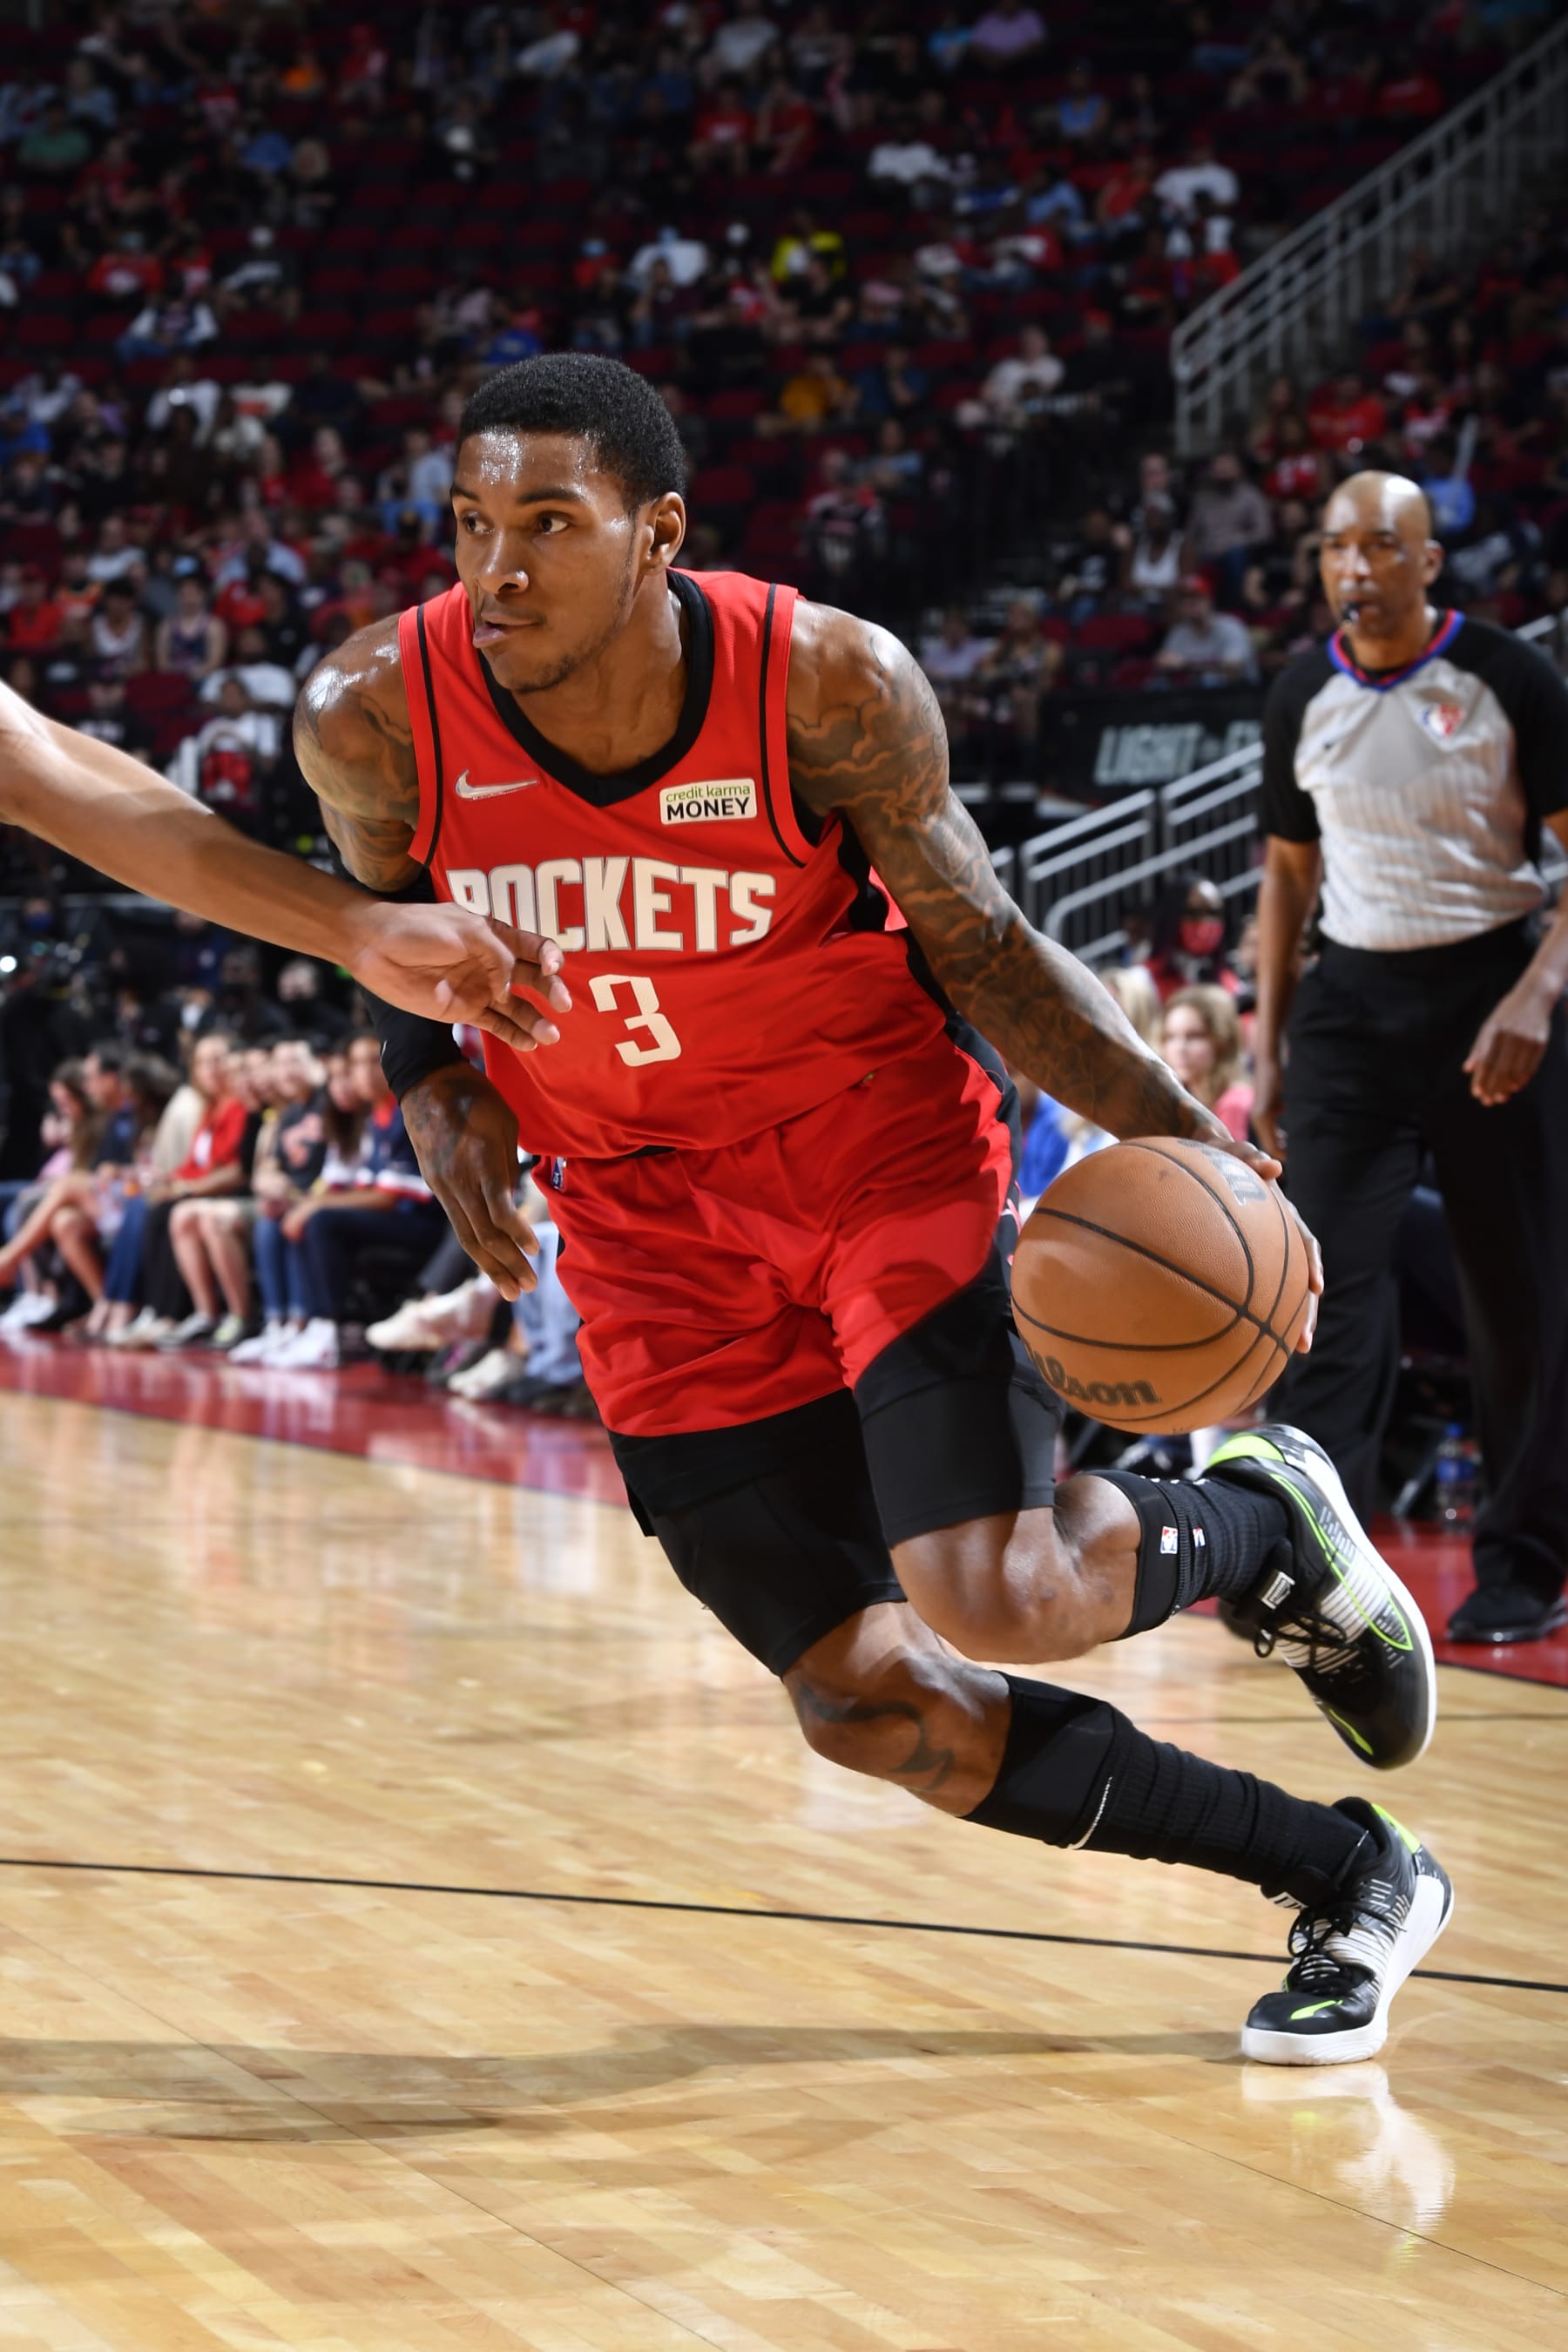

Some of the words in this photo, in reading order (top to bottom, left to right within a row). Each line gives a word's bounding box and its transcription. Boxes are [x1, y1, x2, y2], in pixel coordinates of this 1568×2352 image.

[666, 786, 703, 802] credit
[706, 784, 750, 798] karma
[666, 797, 749, 821] MONEY
[446, 856, 776, 952] ROCKETS
[589, 974, 681, 1067] 3
